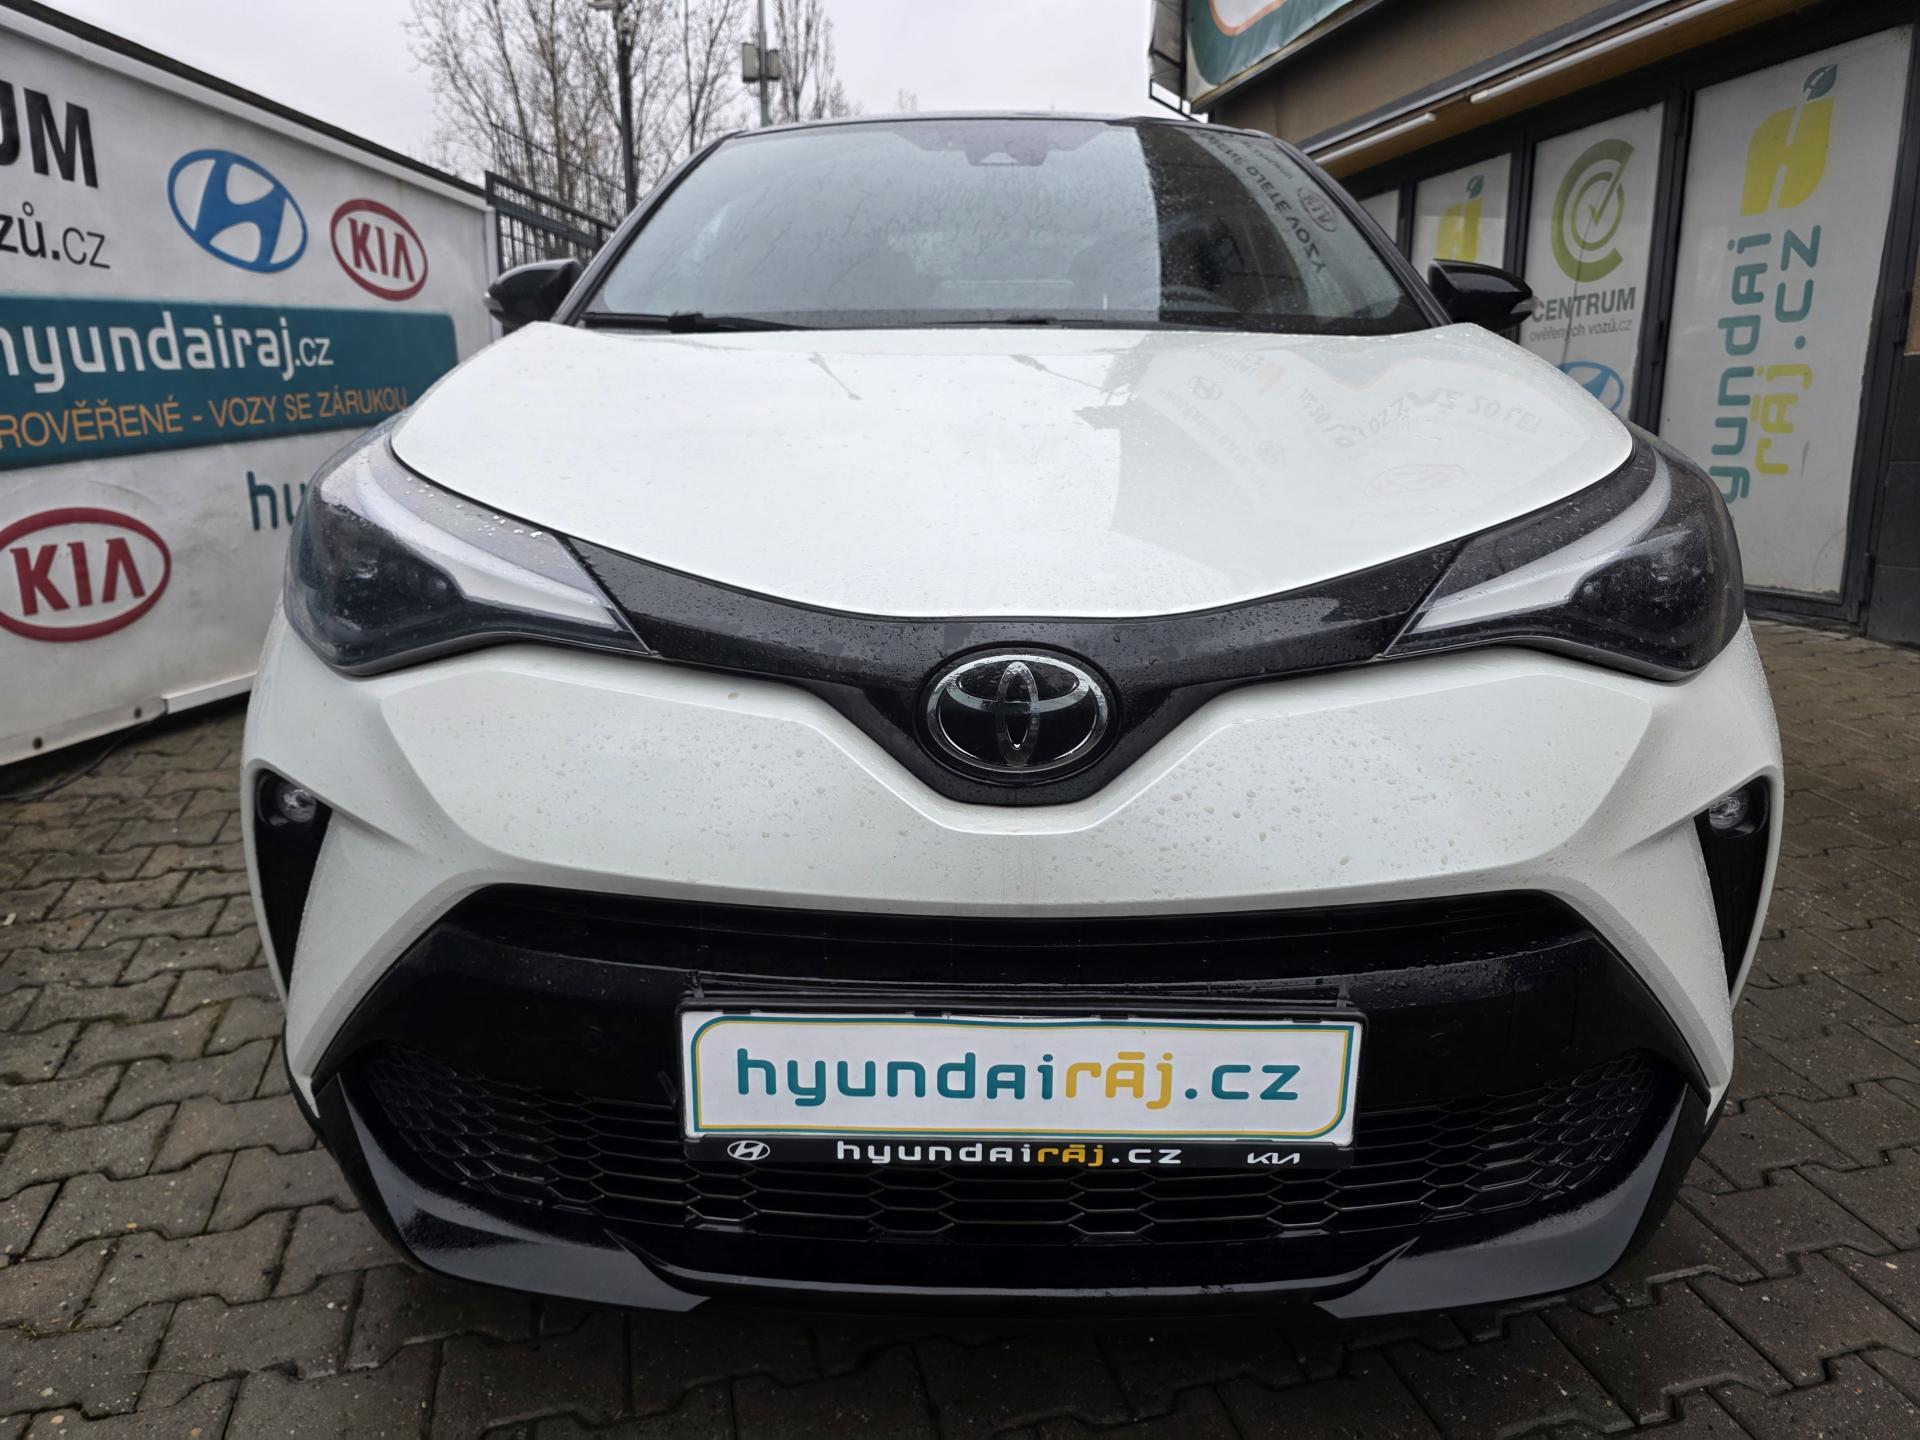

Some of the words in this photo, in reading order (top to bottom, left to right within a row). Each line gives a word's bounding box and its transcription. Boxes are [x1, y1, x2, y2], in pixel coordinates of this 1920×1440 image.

[347, 217, 416, 283] KIA
[1709, 233, 1772, 504] yundai
[208, 396, 277, 428] VOZY
[284, 393, 312, 421] SE
[317, 384, 408, 417] ZÁRUKOU
[10, 538, 147, 618] KIA
